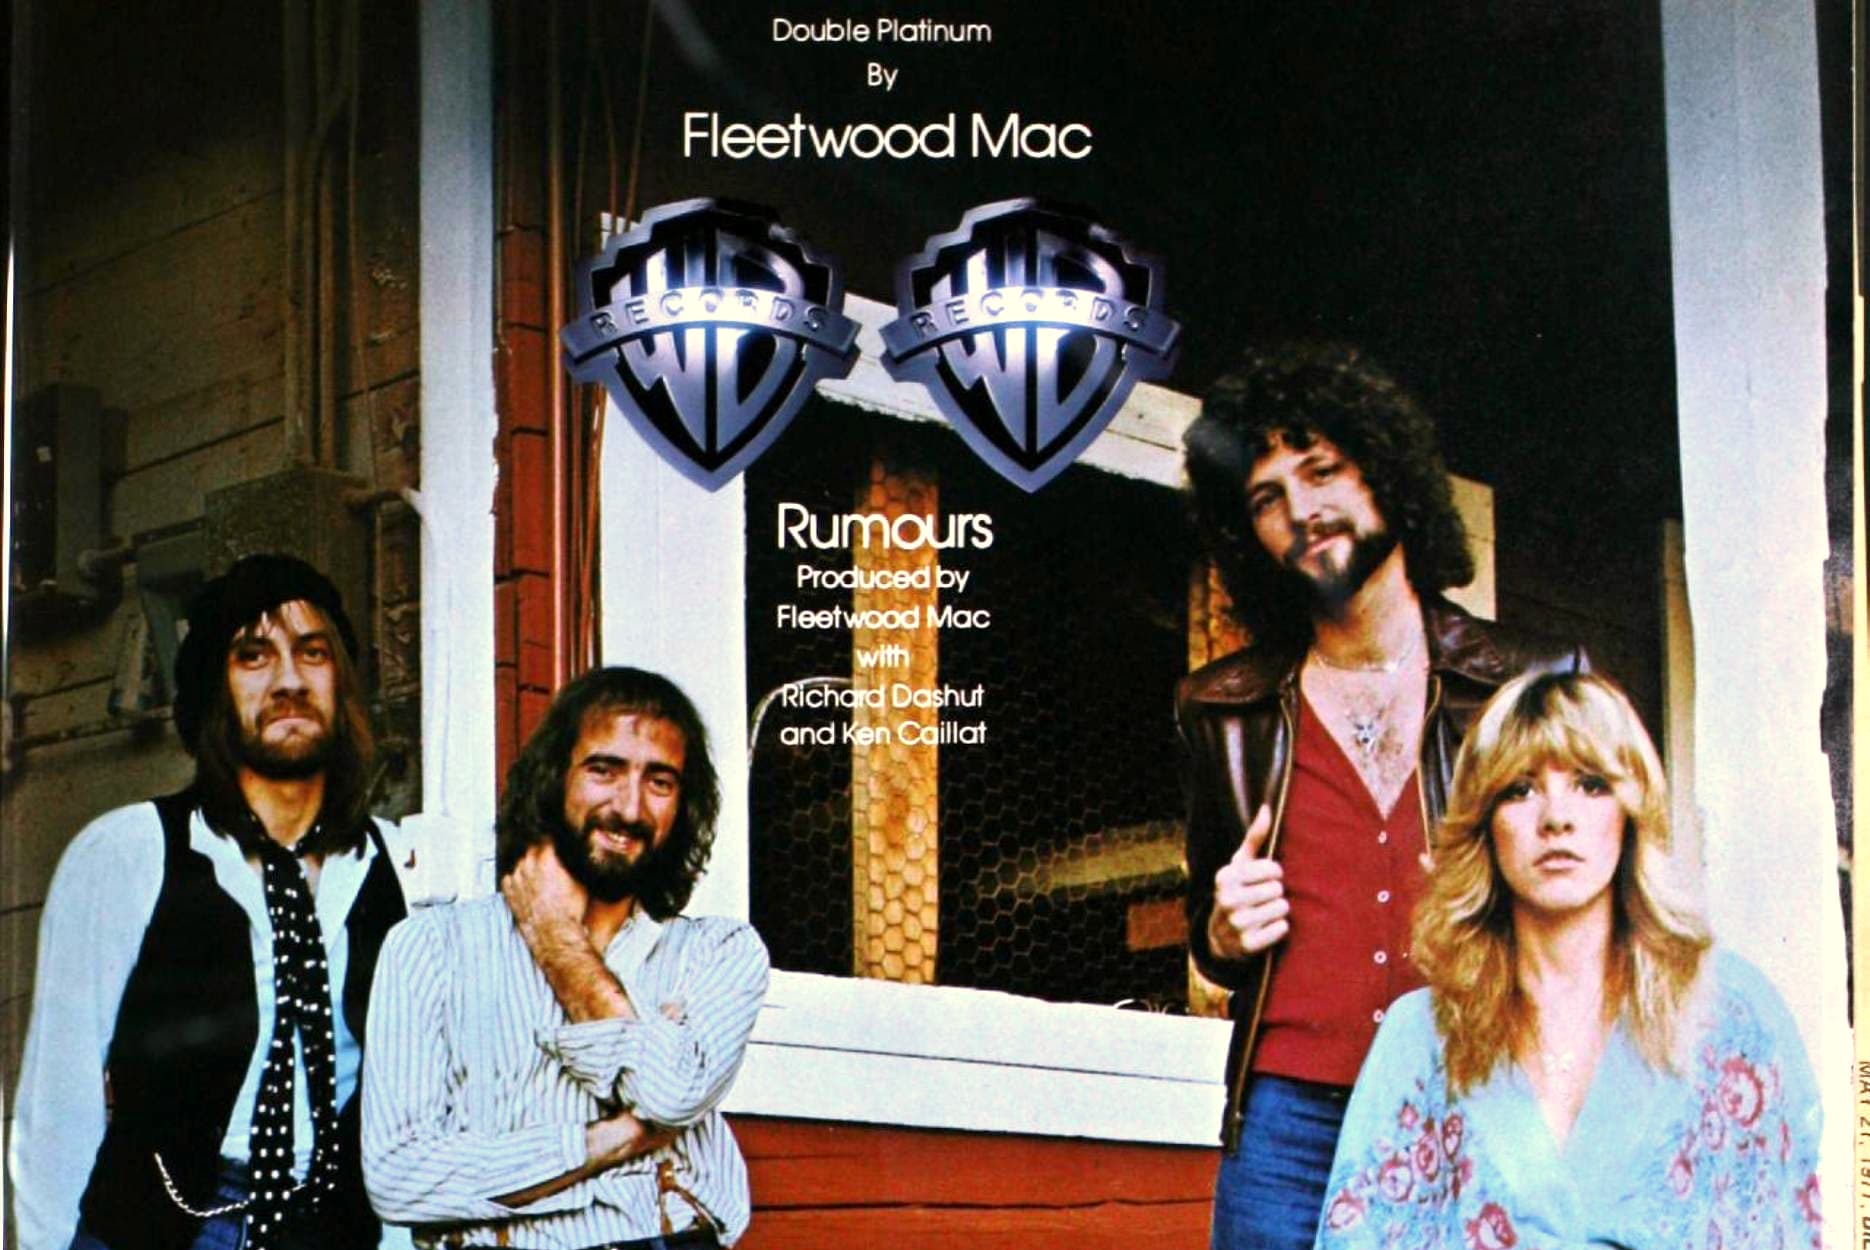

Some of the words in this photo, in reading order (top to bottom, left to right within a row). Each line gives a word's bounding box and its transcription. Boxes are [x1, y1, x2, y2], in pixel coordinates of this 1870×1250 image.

[773, 18, 870, 42] Double
[878, 18, 991, 42] Platinum
[868, 62, 898, 91] By
[684, 112, 955, 159] Fleetwood
[972, 113, 1092, 159] Mac
[589, 288, 828, 336] RECORDS
[909, 288, 1148, 336] RECORDS
[778, 502, 994, 550] Rumours
[797, 564, 931, 589] Produced
[936, 565, 970, 593] by
[777, 604, 920, 629] Fleetwood
[927, 605, 990, 629] Mac
[857, 644, 910, 668] with
[779, 682, 886, 709] Richard
[892, 683, 985, 708] Dashut
[780, 722, 835, 746] and
[843, 720, 891, 747] Ken
[897, 720, 987, 745] Caillat
